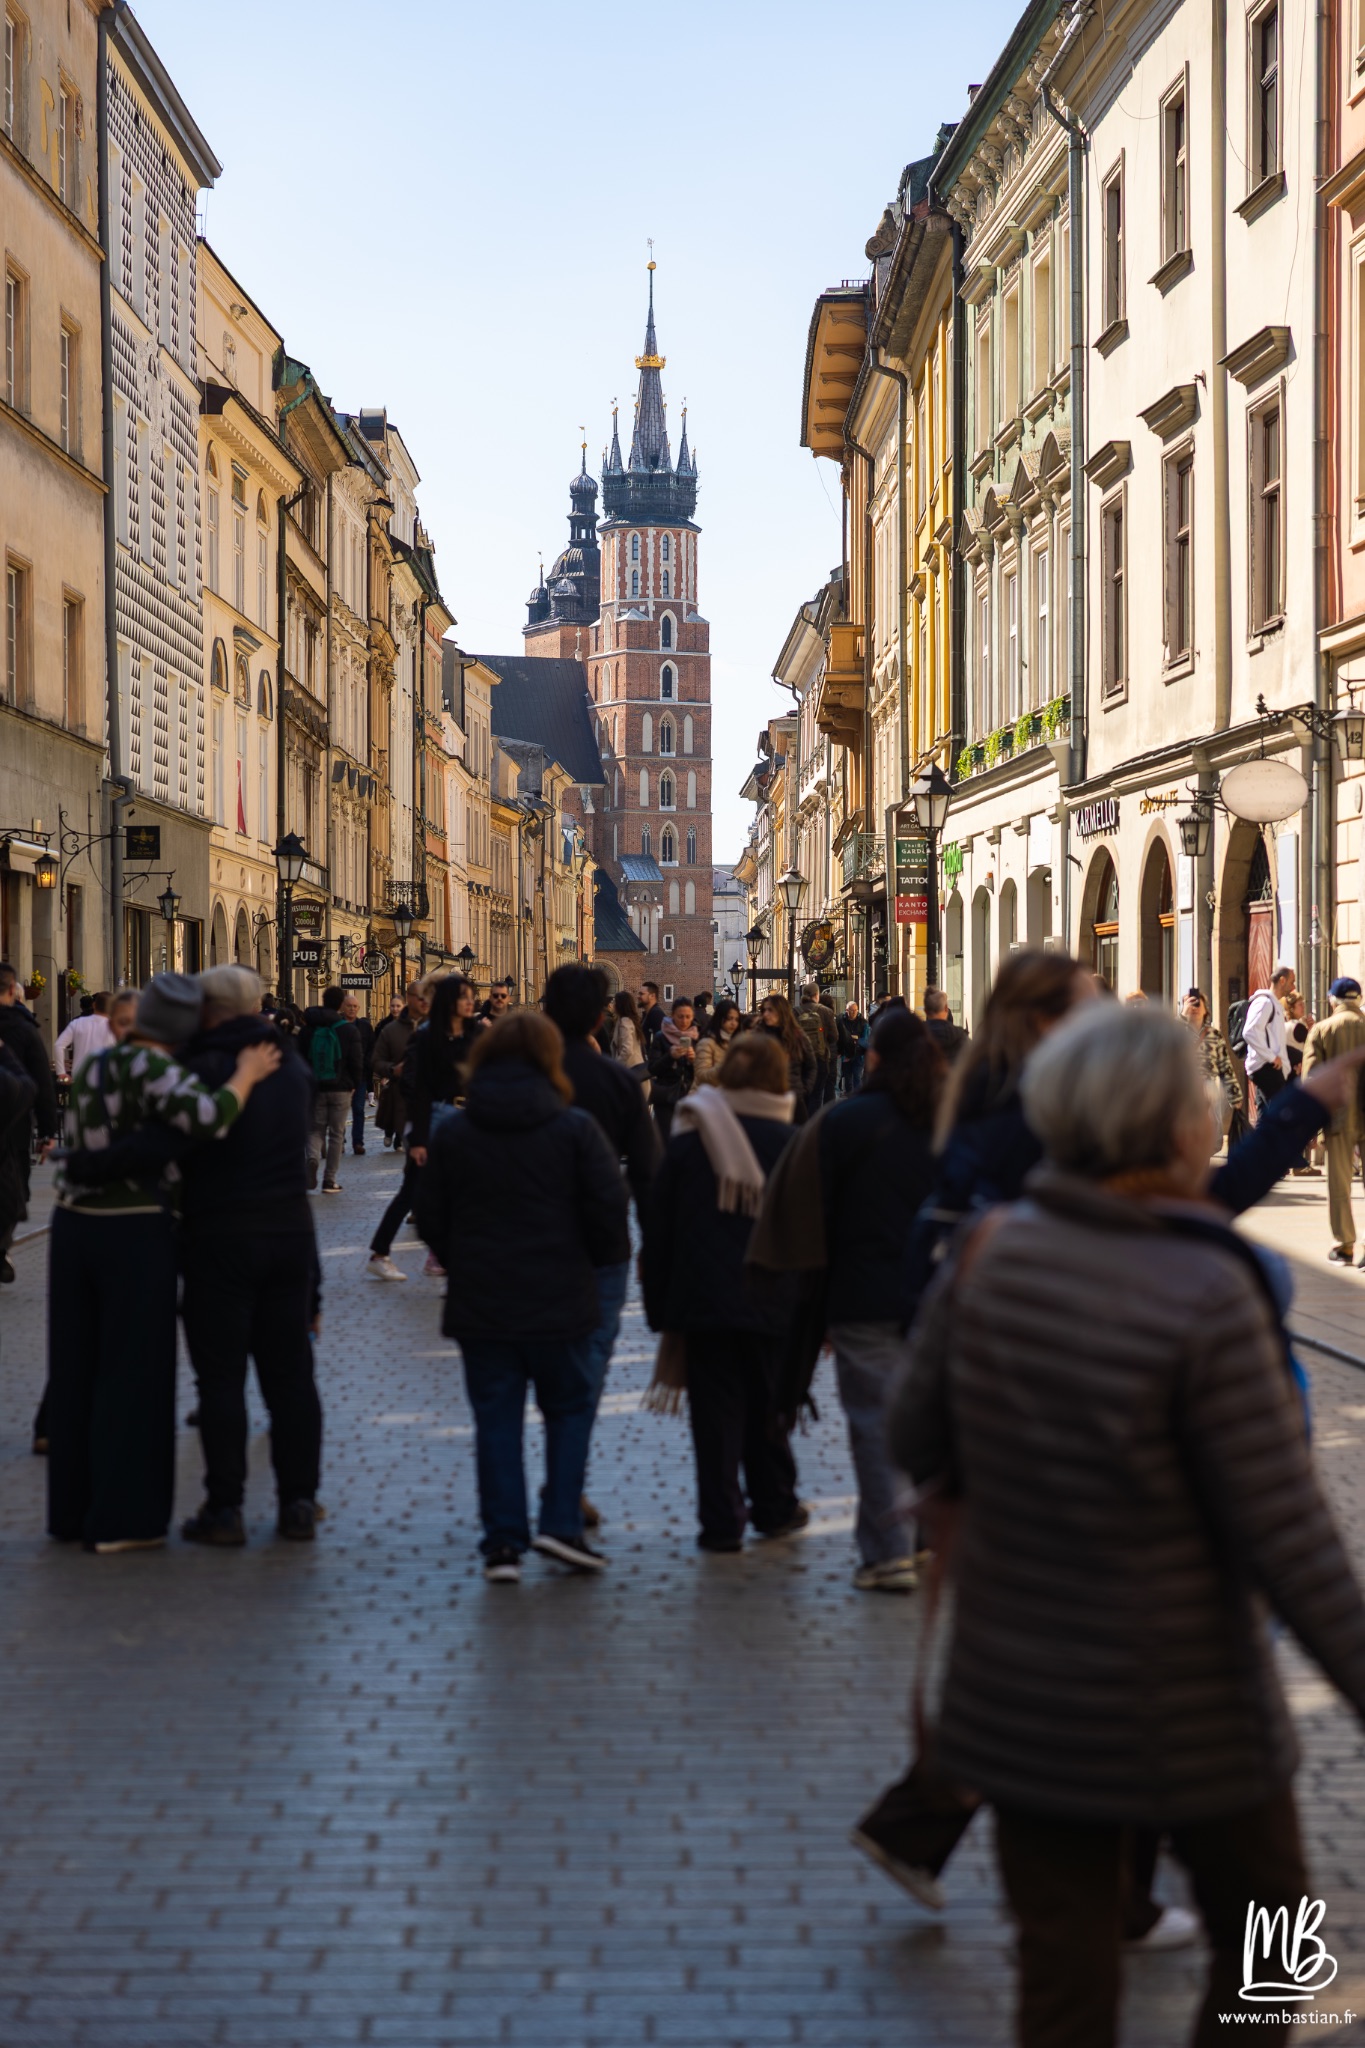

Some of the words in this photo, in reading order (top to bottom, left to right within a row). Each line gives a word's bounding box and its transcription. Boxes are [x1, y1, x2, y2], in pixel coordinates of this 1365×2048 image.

[1348, 731, 1362, 744] 42
[1075, 797, 1116, 836] KARMELLO
[1186, 834, 1196, 845] 40
[292, 951, 318, 961] PUB
[342, 977, 372, 986] HOSTEL
